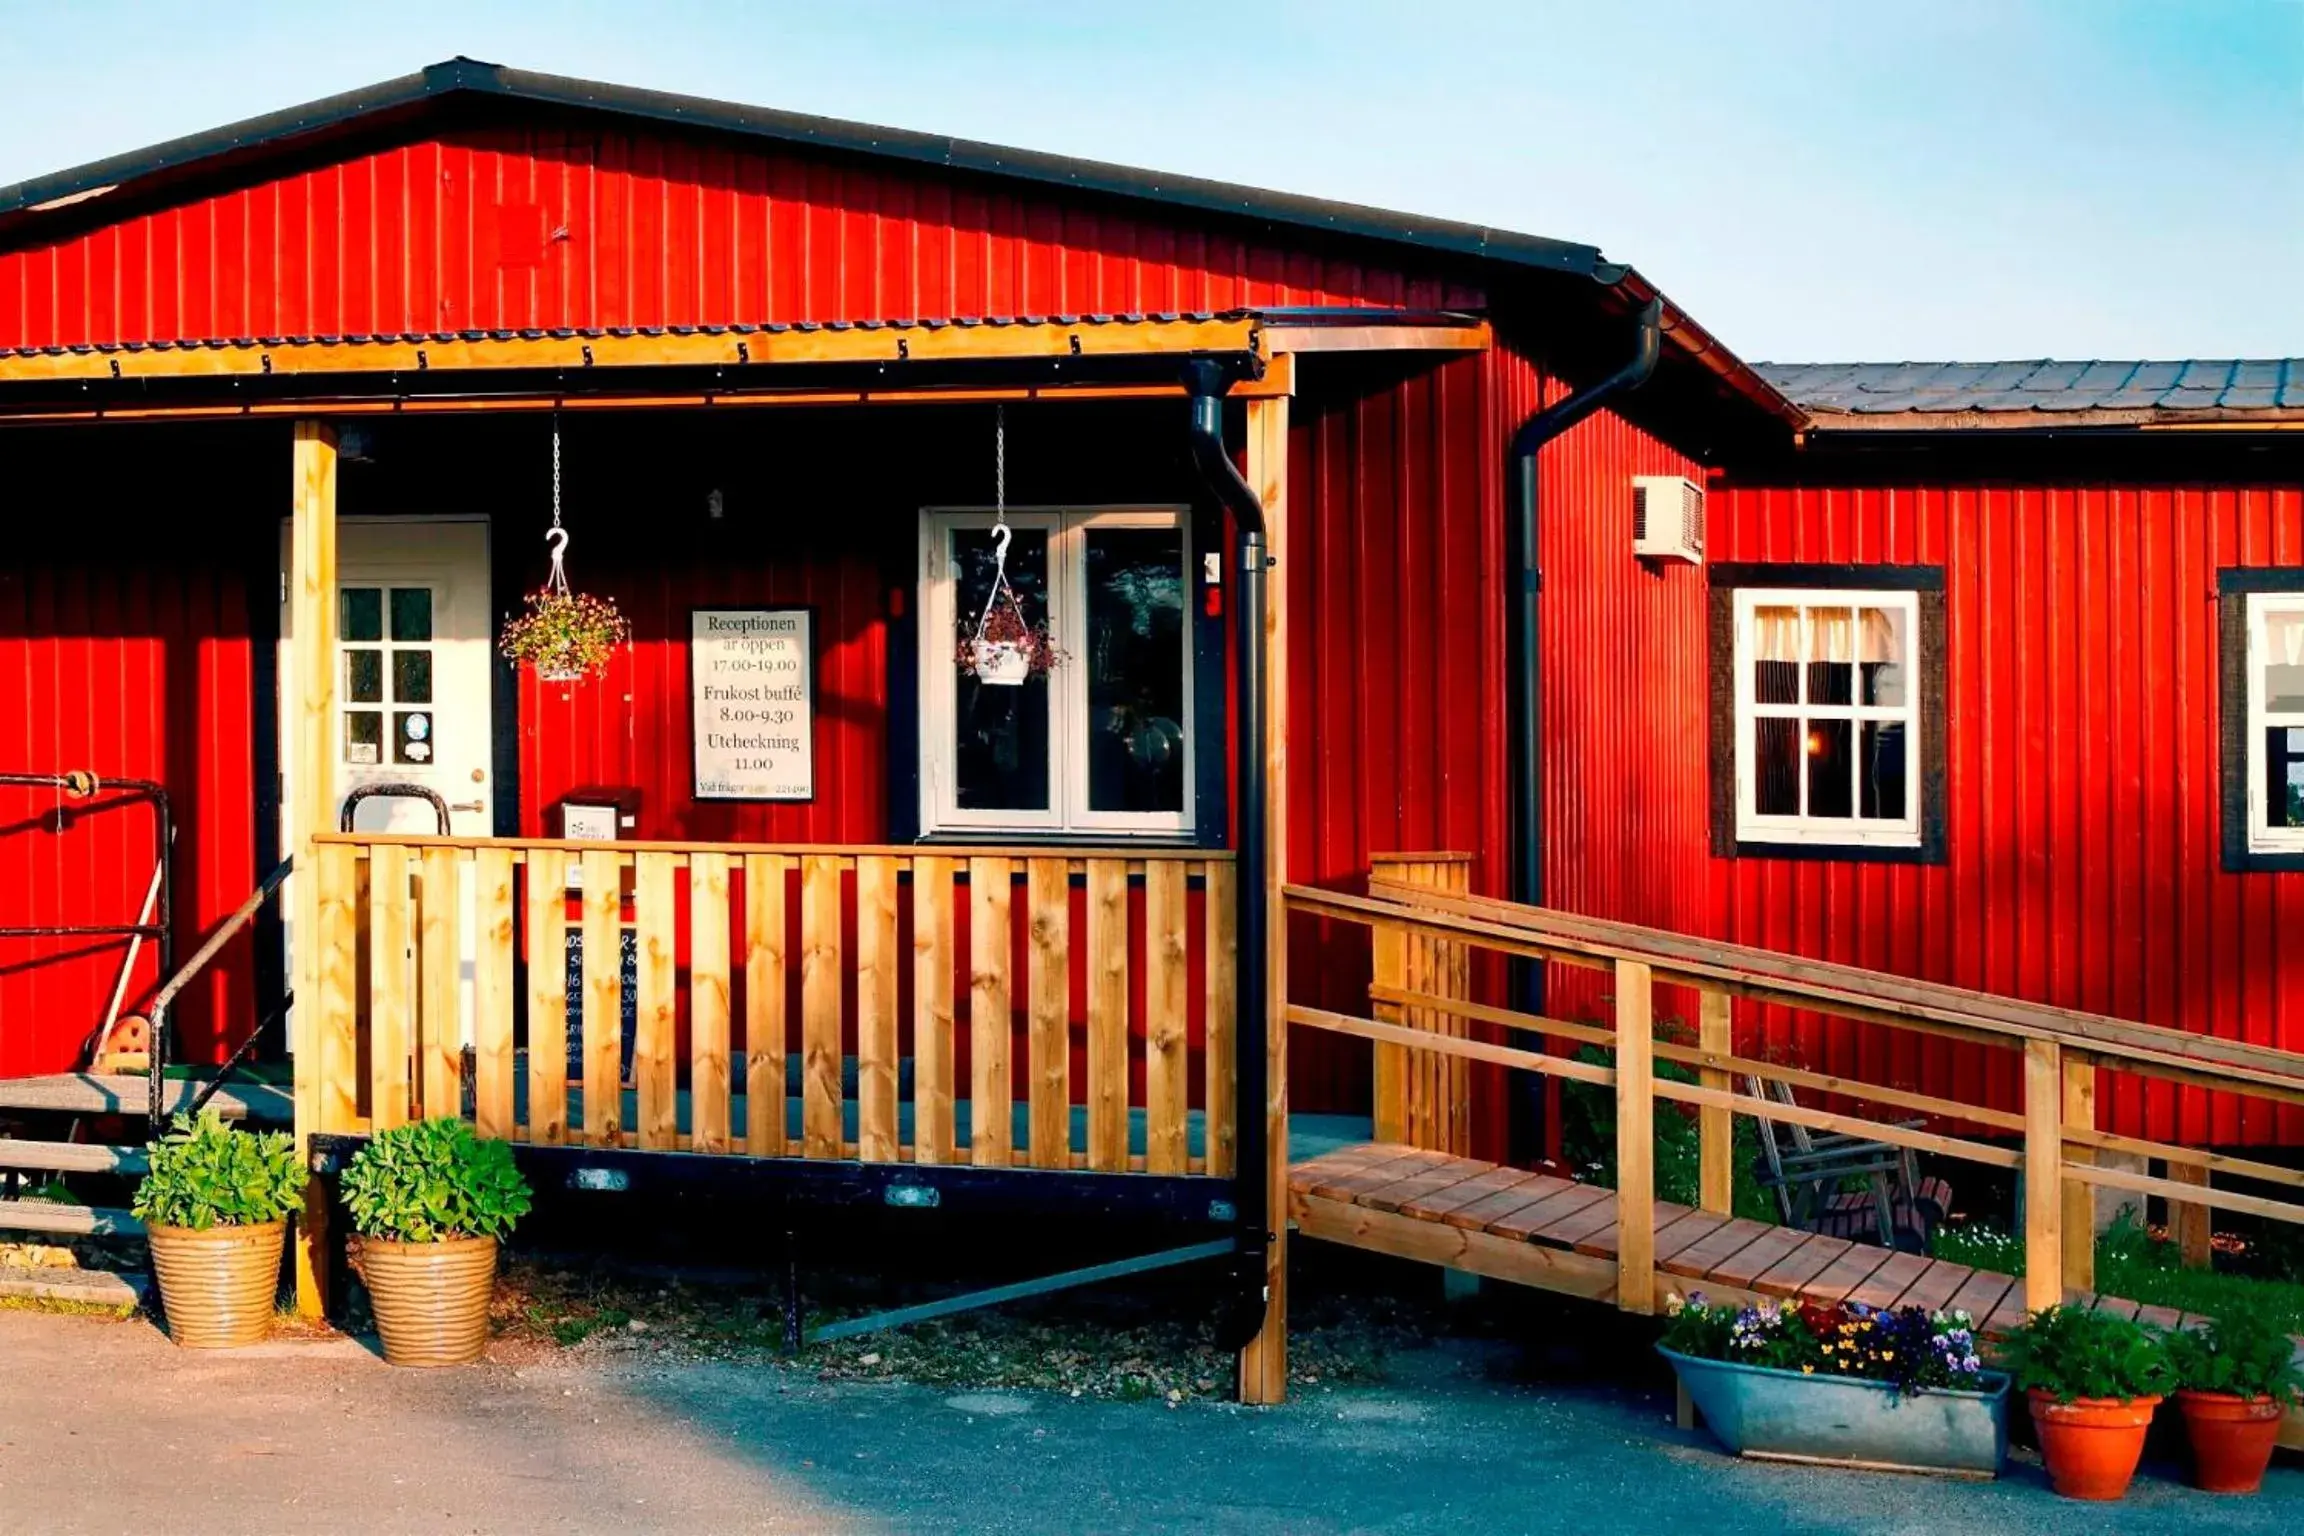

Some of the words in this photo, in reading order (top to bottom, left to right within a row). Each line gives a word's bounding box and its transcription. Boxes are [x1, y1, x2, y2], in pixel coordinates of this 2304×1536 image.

[708, 615, 796, 634] Receptionen
[723, 637, 737, 651] är
[741, 636, 785, 655] öppen
[713, 660, 797, 674] 17.00-19.00
[704, 685, 760, 701] Frukost
[764, 685, 802, 701] buffé
[720, 706, 794, 724] 8.00-9.30
[707, 733, 800, 752] Utcheckning
[734, 757, 773, 771] 11.00
